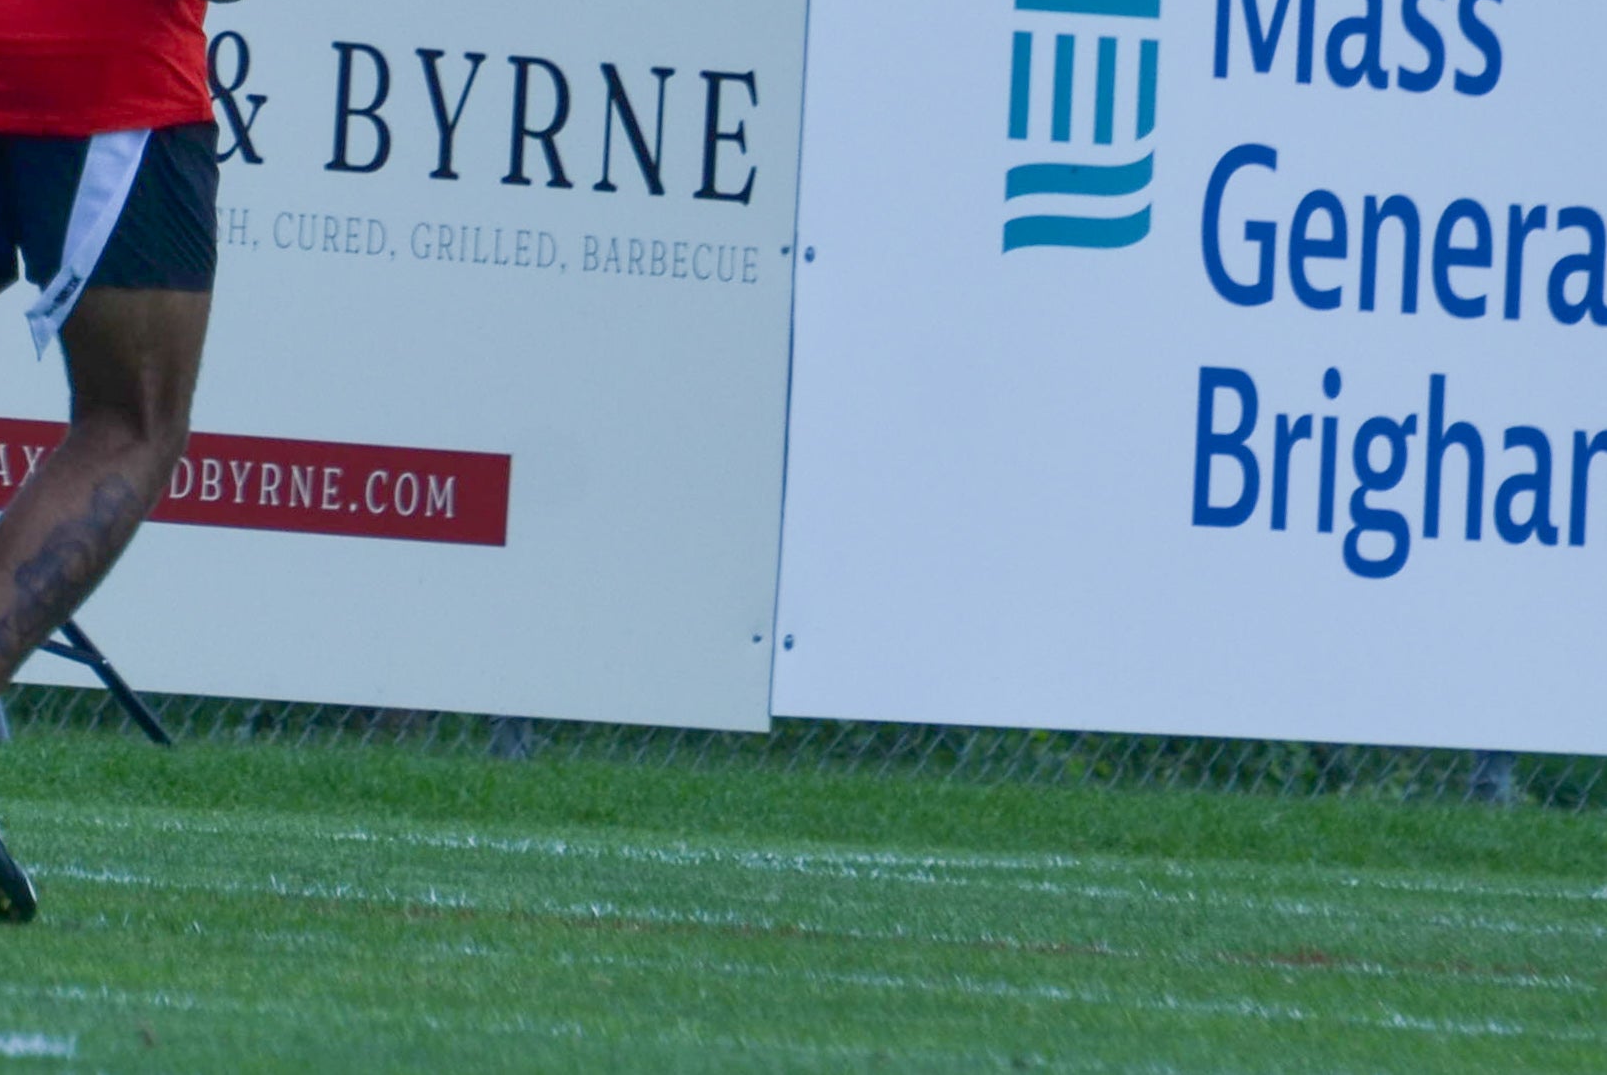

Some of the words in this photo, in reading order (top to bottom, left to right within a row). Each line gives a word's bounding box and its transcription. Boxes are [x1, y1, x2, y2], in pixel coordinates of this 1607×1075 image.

[324, 41, 759, 206] BYRNE
[272, 211, 396, 261] CURED,
[410, 222, 568, 273] GRILLED,
[582, 235, 760, 284] BARBECUE
